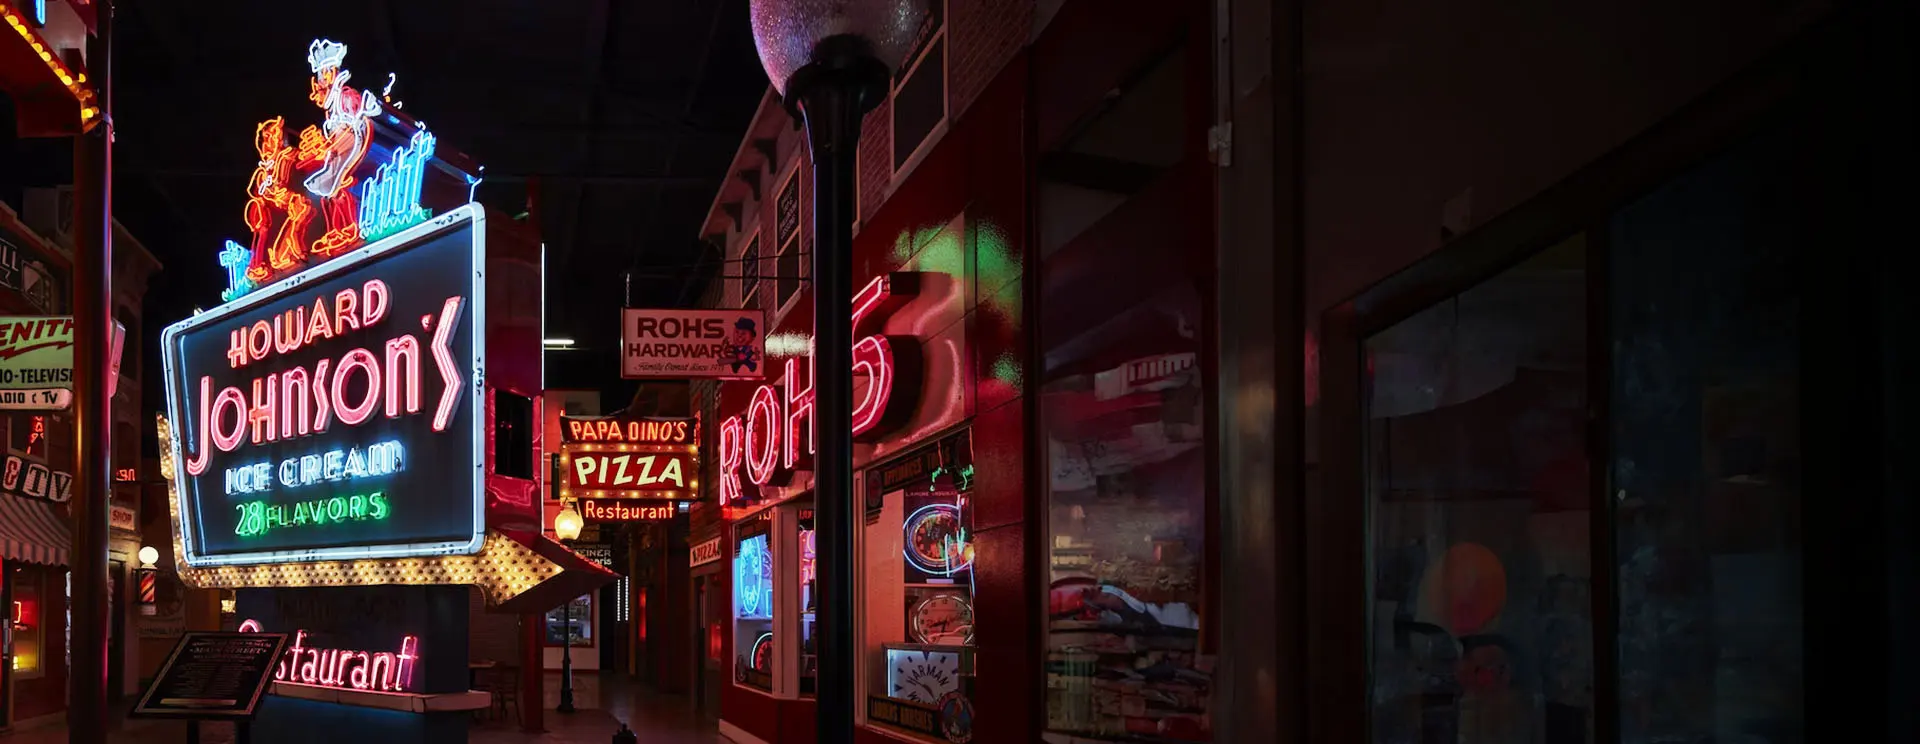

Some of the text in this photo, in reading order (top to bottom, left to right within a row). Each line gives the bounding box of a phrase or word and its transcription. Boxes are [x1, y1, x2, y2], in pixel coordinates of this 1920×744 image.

[228, 279, 393, 369] HOWARD
[637, 317, 725, 339] ROHS
[42, 392, 58, 404] TV
[569, 421, 688, 442] PAPA DINO'S
[29, 466, 71, 499] TV
[225, 439, 405, 497] ICE CREAM
[575, 455, 683, 487] PIZZA
[234, 492, 389, 537] 28 FLAVORS
[586, 500, 674, 519] Restaurant
